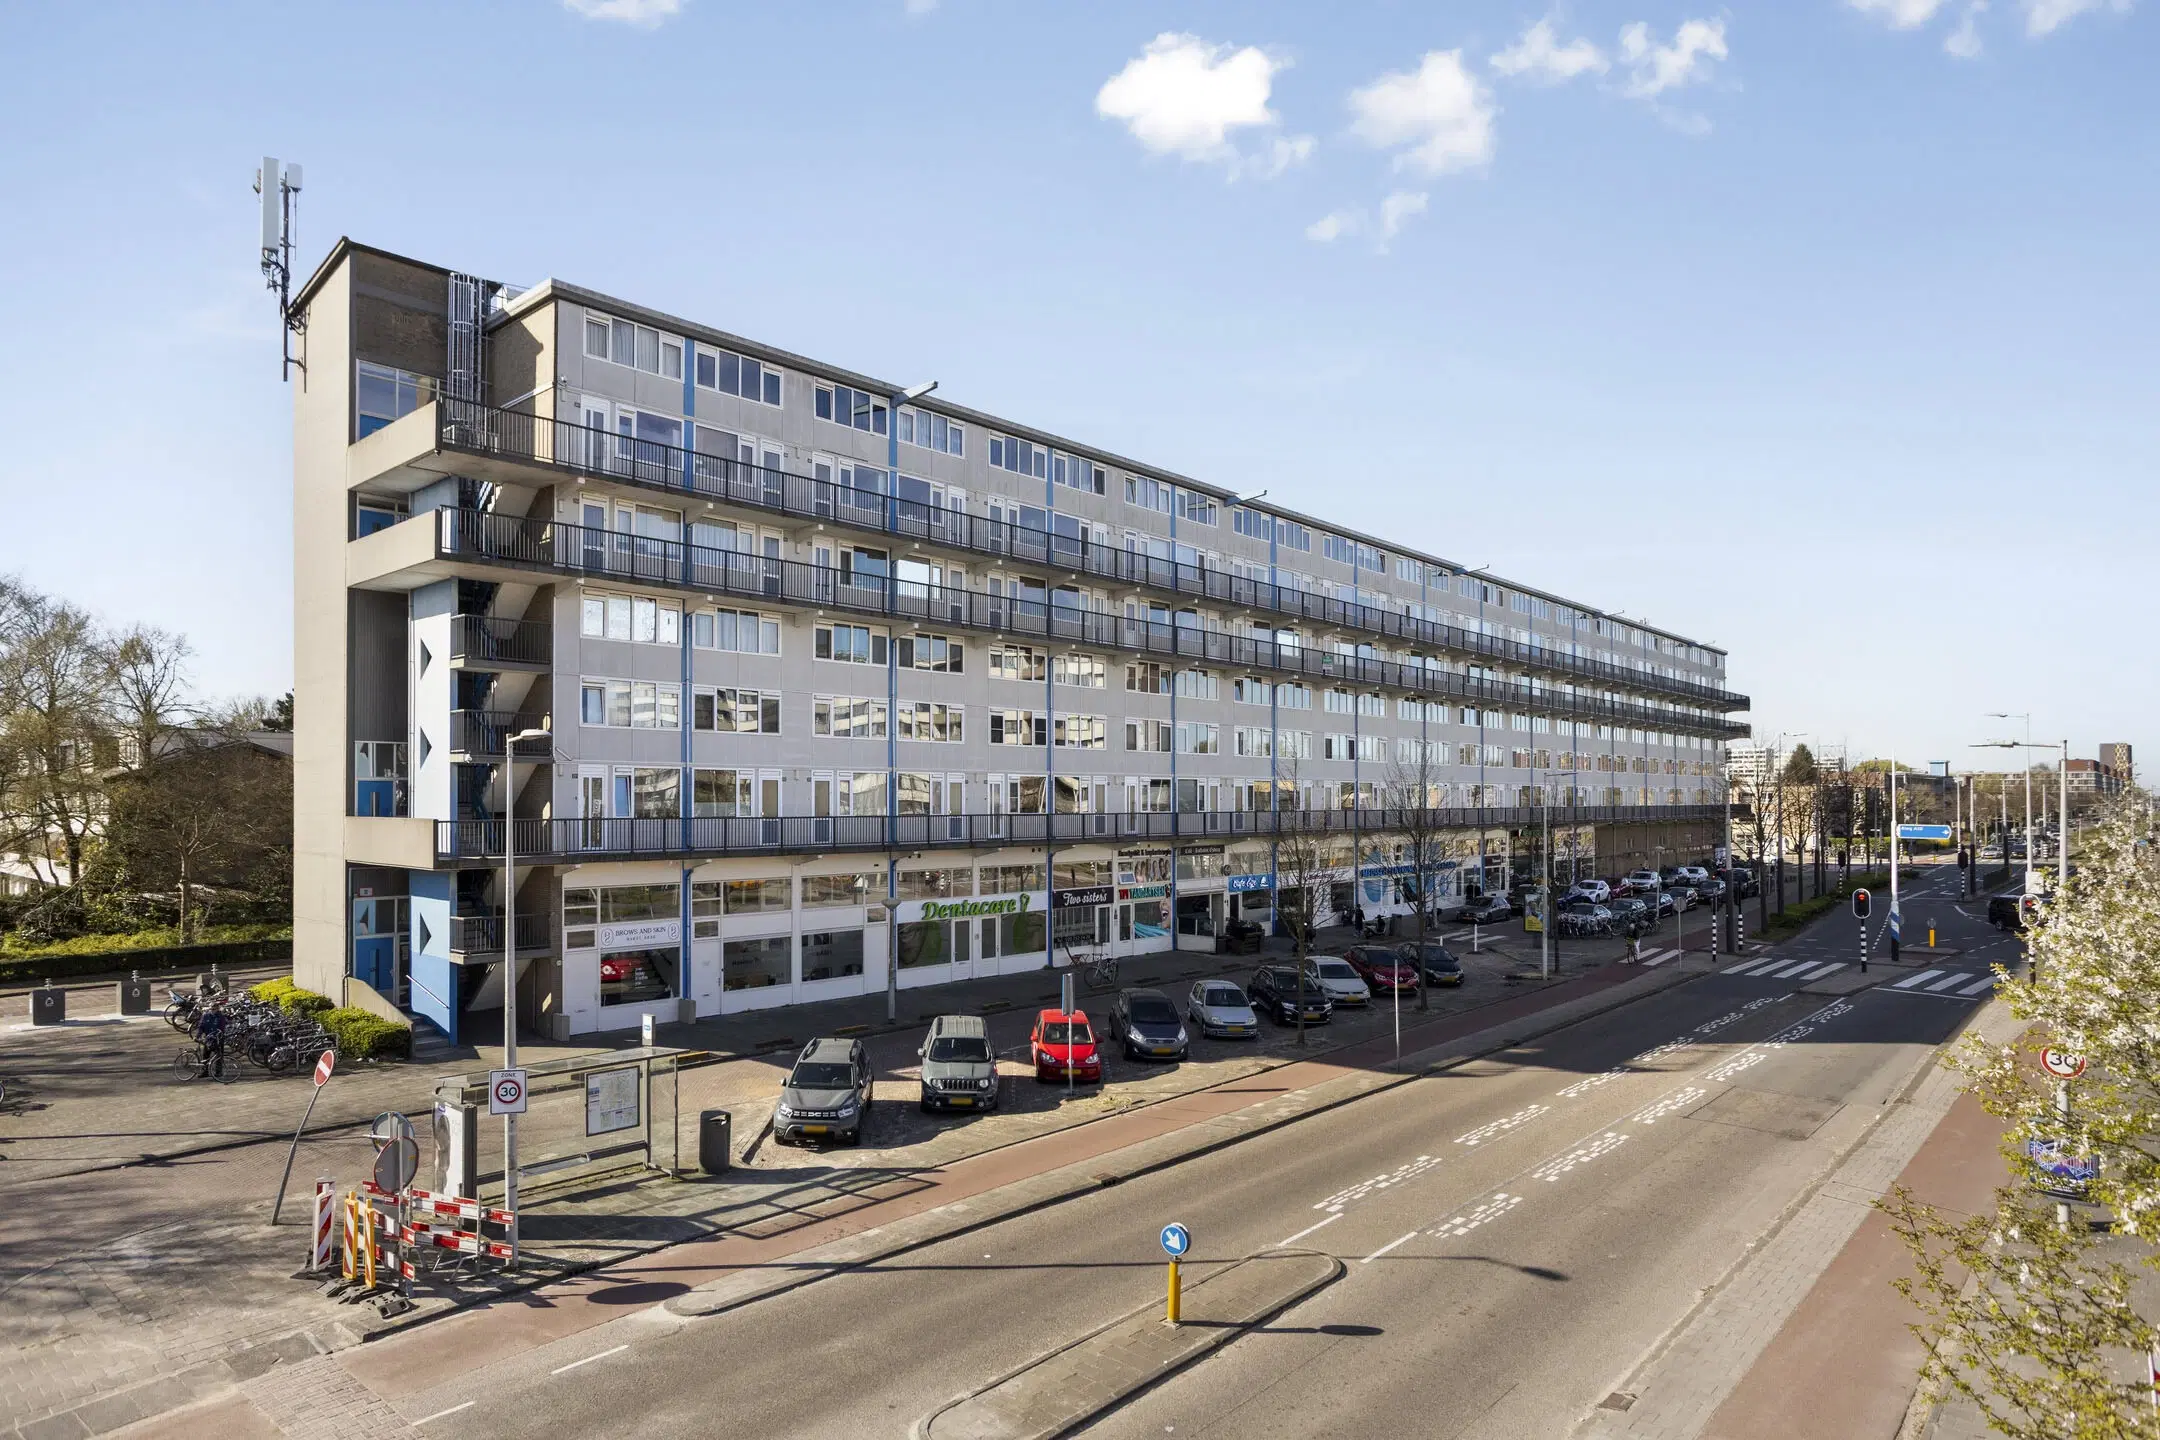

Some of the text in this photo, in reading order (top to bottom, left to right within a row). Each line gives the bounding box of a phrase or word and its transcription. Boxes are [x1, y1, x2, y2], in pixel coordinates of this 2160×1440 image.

[1062, 892, 1081, 906] Two
[1081, 891, 1108, 904] sisters
[921, 898, 1017, 920] Dentacare
[615, 928, 638, 936] BROWS
[2050, 1053, 2078, 1068] 30
[500, 1087, 517, 1097] 30
